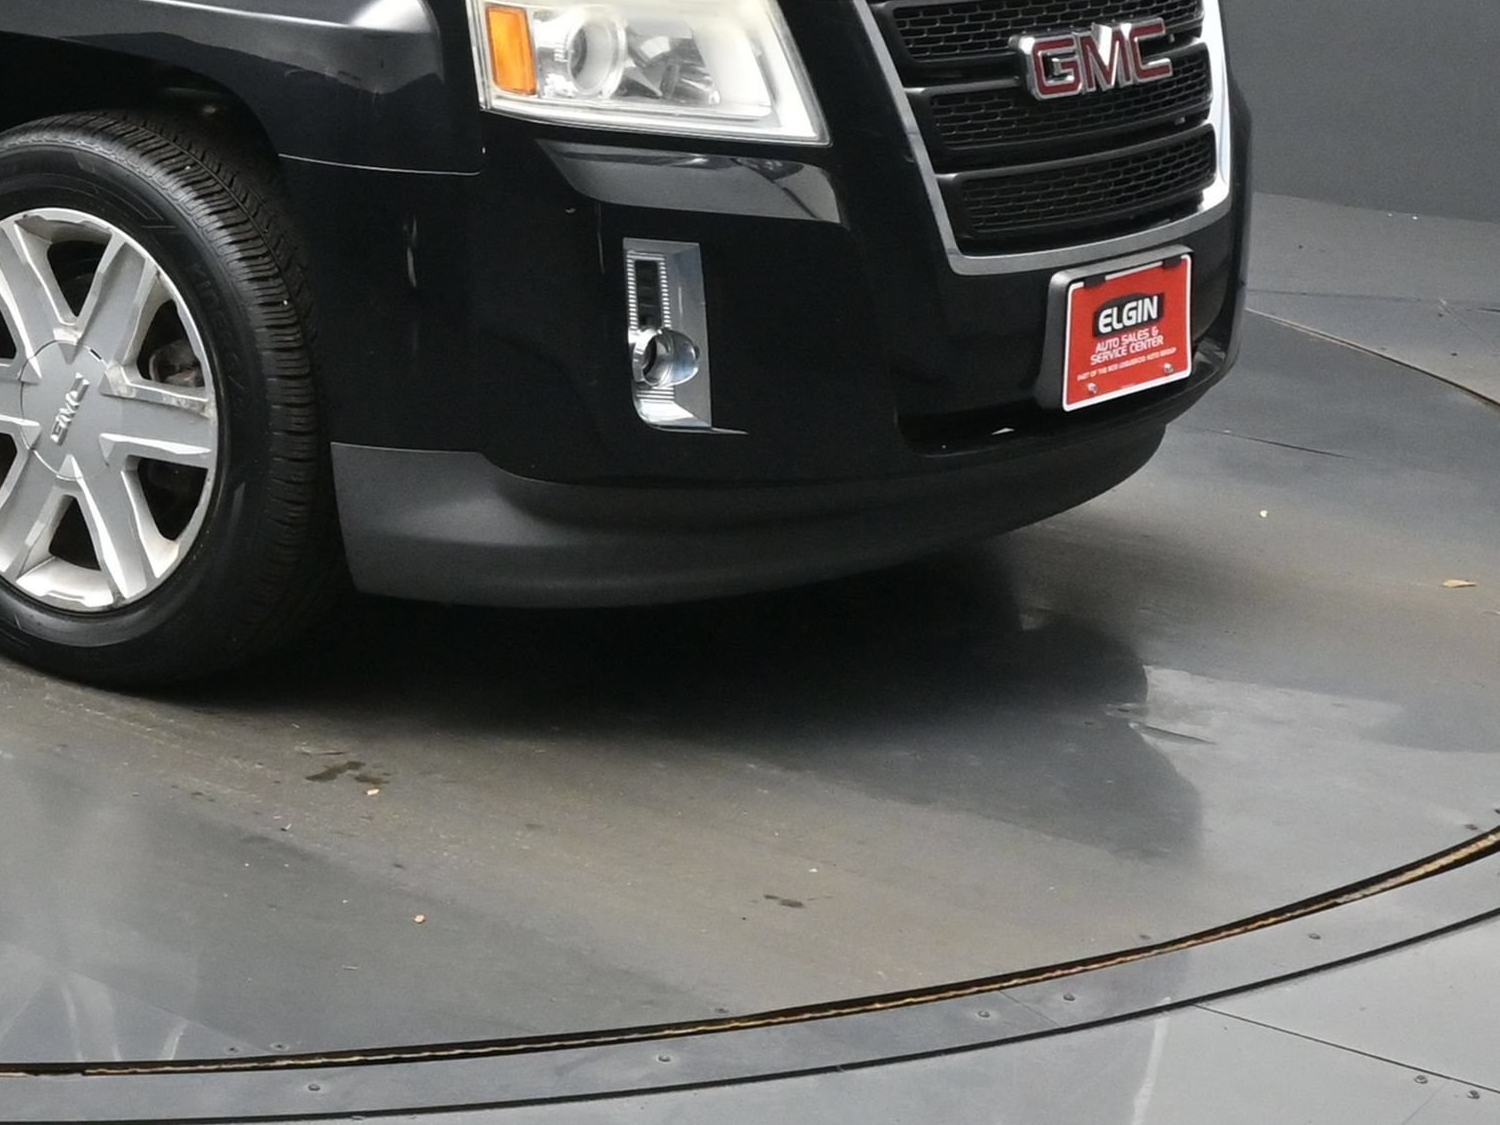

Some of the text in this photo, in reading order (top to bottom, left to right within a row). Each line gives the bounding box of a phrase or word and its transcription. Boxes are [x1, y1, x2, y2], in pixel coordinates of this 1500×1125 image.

[1016, 16, 1174, 101] GMC
[1098, 294, 1159, 334] ELGIN
[1090, 345, 1128, 365] SERVICE
[1129, 335, 1164, 354] CENTER
[1095, 326, 1160, 353] AUTO SALES &
[50, 372, 91, 447] GMC
